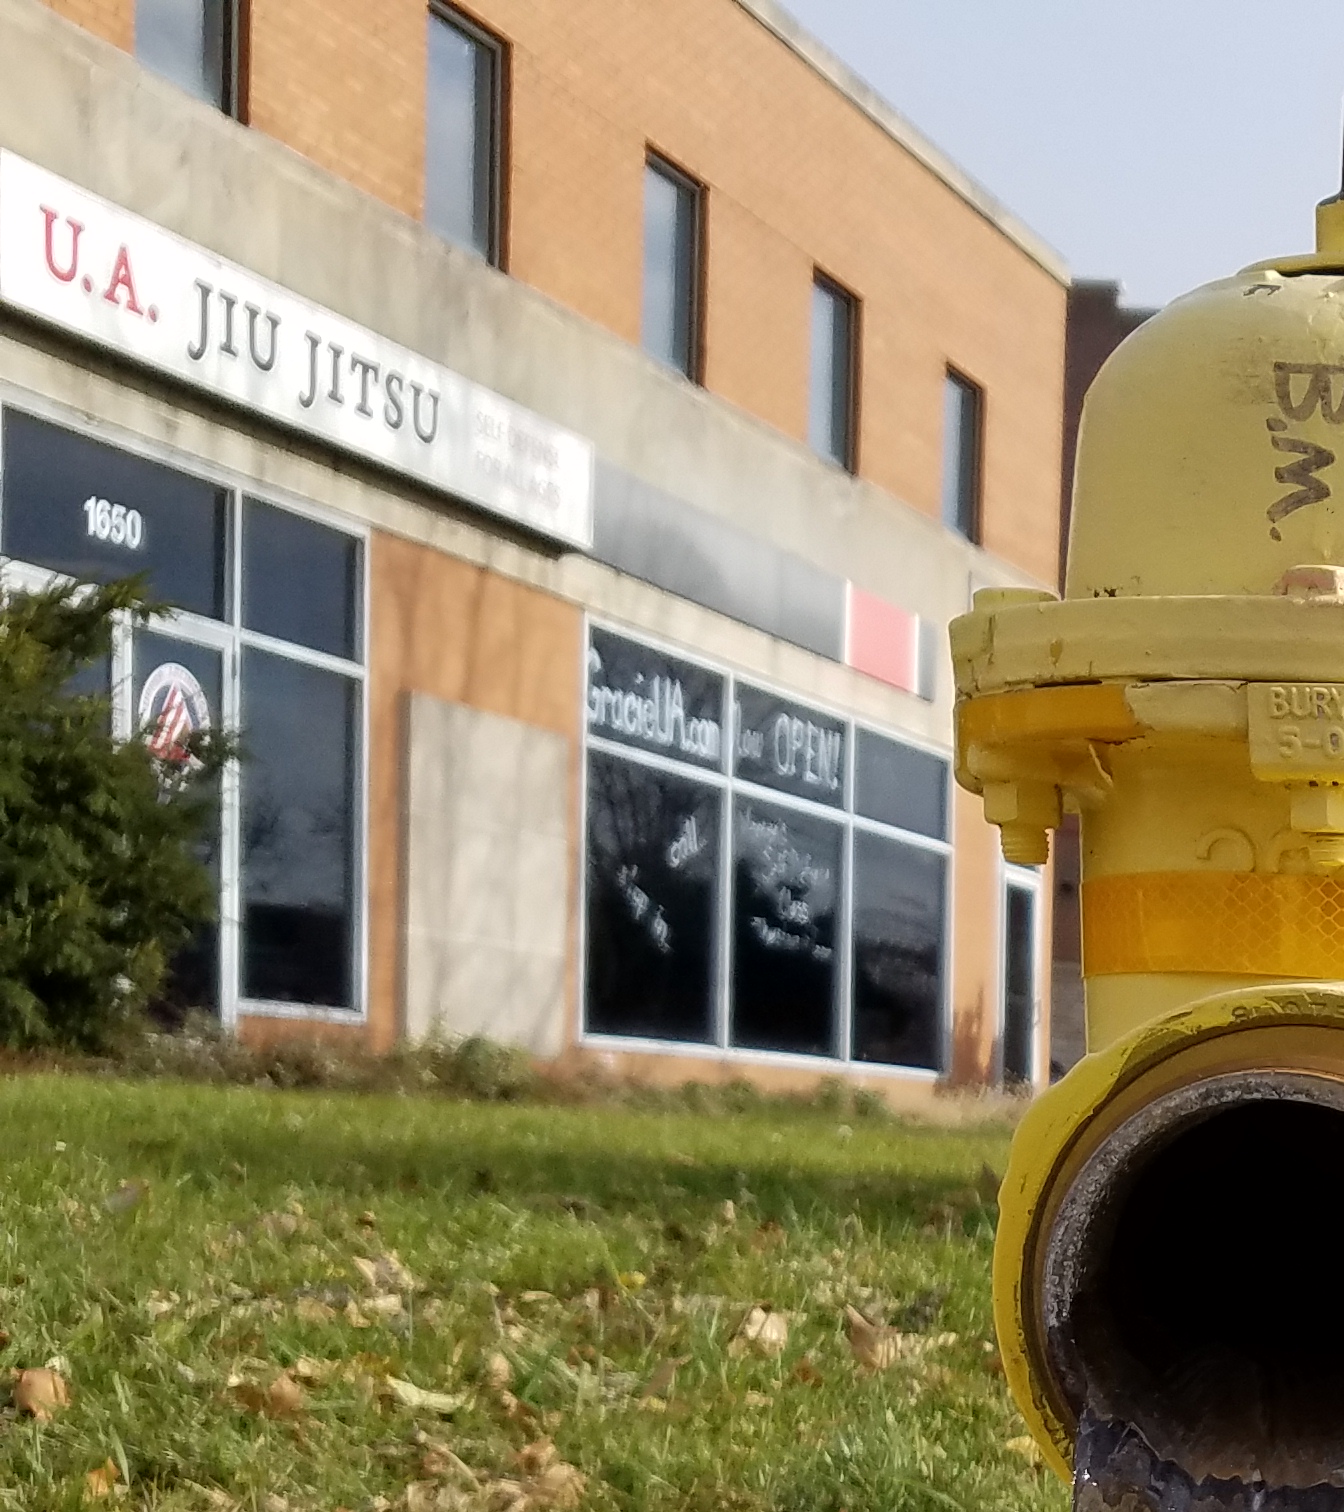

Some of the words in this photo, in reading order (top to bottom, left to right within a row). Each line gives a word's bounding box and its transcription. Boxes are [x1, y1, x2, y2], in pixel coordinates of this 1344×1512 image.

[39, 204, 160, 323] U.A.
[187, 277, 282, 372] JIU
[298, 329, 441, 444] JITSU
[84, 496, 142, 549] 1650
